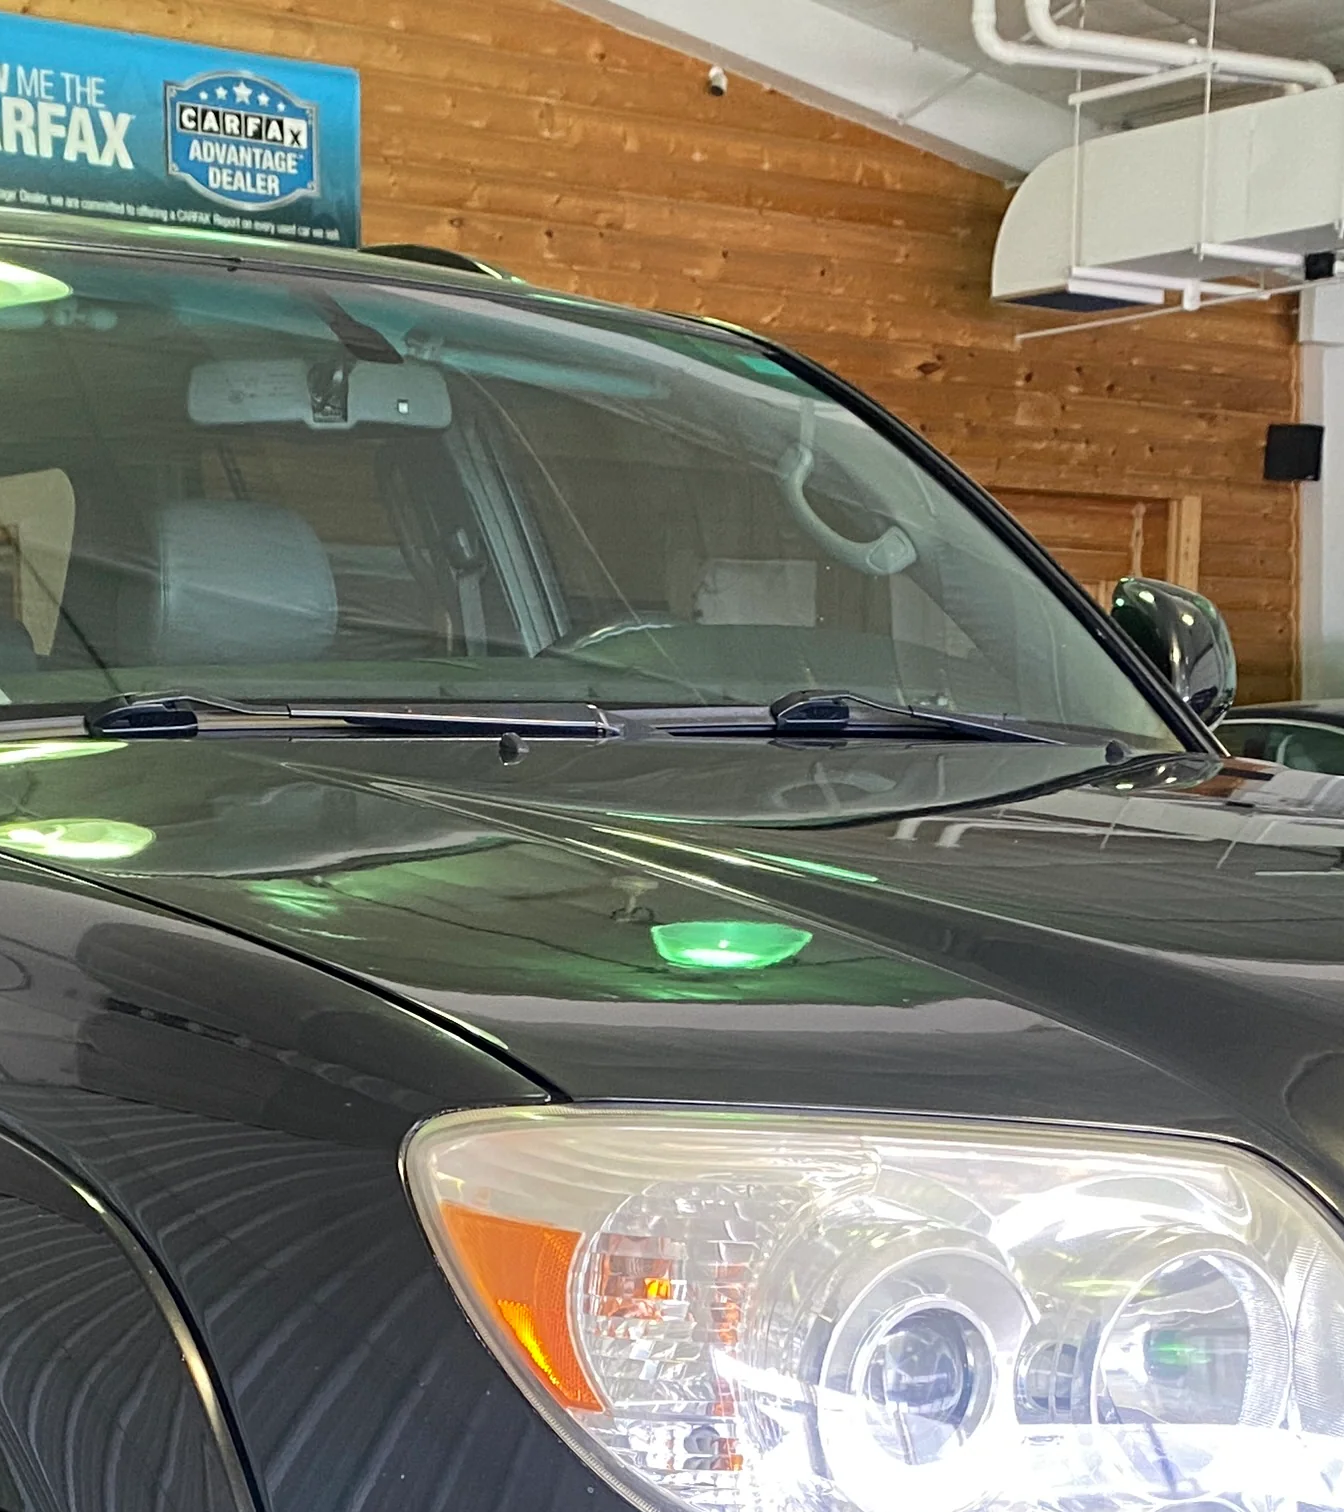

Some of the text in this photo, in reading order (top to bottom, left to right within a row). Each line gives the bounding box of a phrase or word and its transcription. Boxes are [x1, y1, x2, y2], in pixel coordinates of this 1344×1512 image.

[16, 64, 55, 101] ME
[60, 71, 106, 108] THE
[181, 107, 302, 148] CARFAX
[189, 139, 298, 174] ADVANTAGE
[208, 166, 280, 197] DEALER
